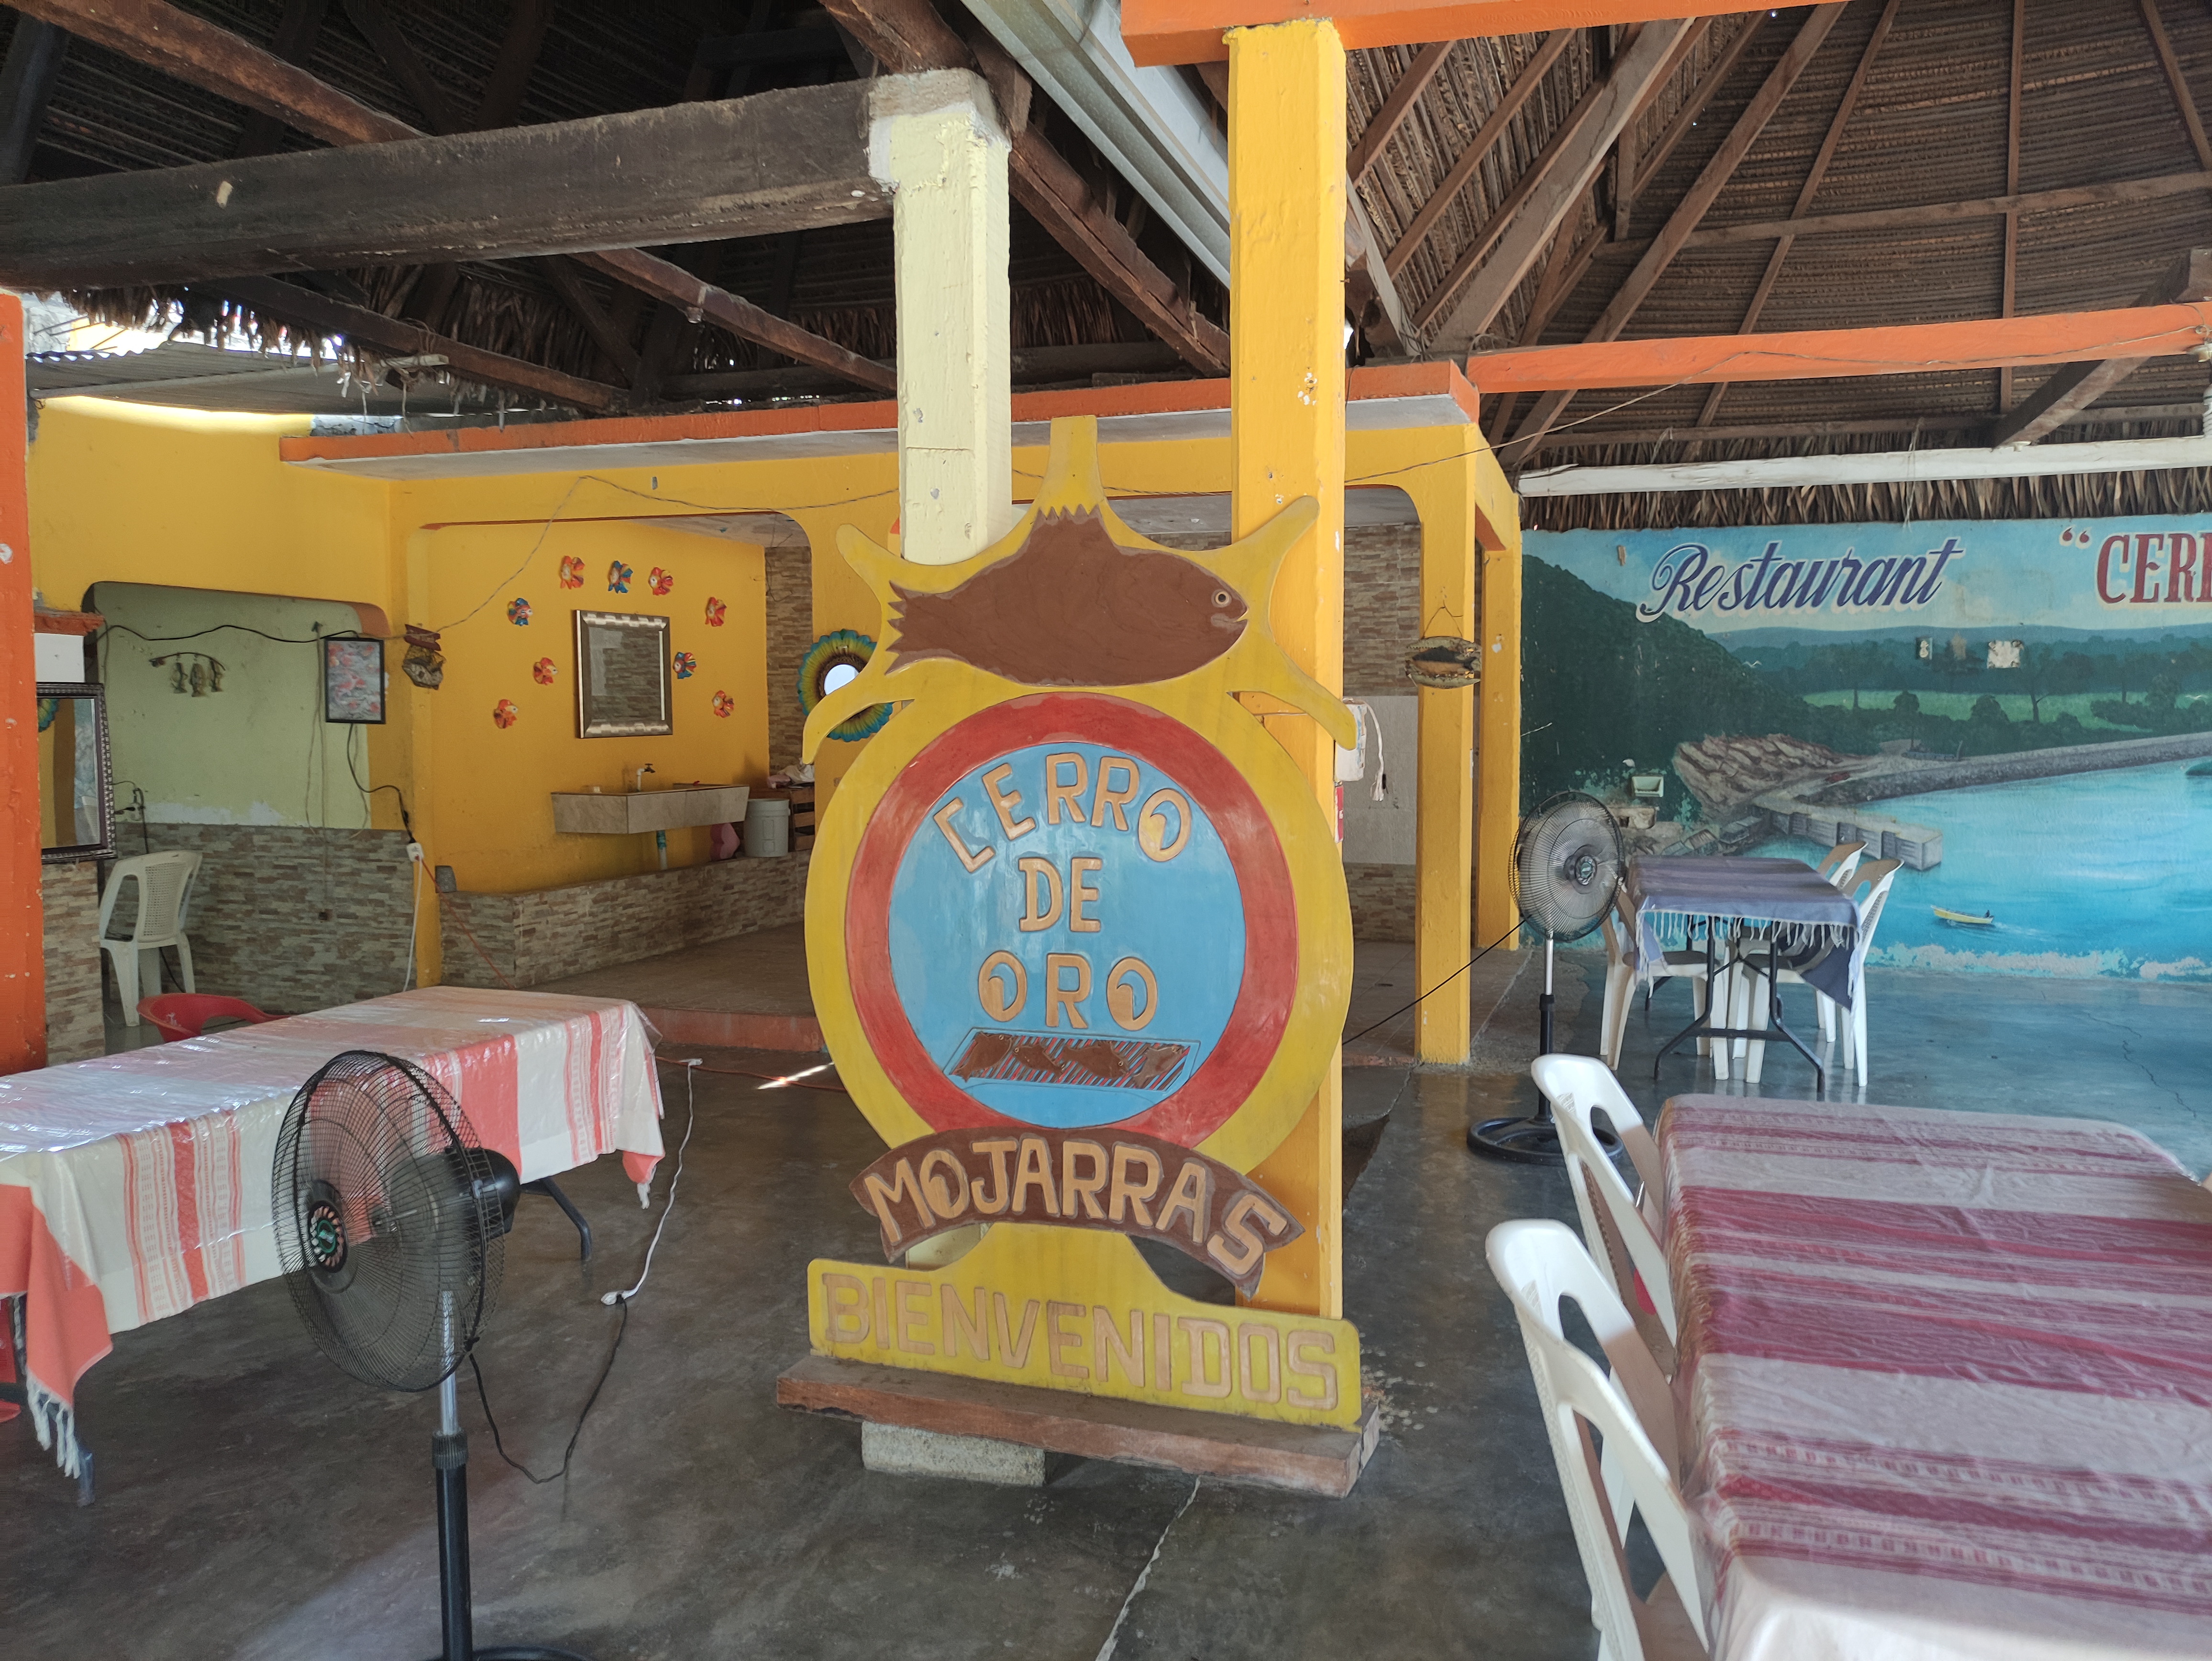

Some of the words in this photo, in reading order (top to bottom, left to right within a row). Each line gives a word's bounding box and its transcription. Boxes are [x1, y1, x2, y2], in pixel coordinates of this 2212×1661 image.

[1639, 538, 1964, 614] Restaurant
[933, 753, 1192, 874] CERRO
[1018, 856, 1102, 932] DE
[978, 950, 1158, 1030] ORO
[863, 1137, 1289, 1276] MOJARRAS
[821, 1273, 1339, 1411] BIENVENIDOS
